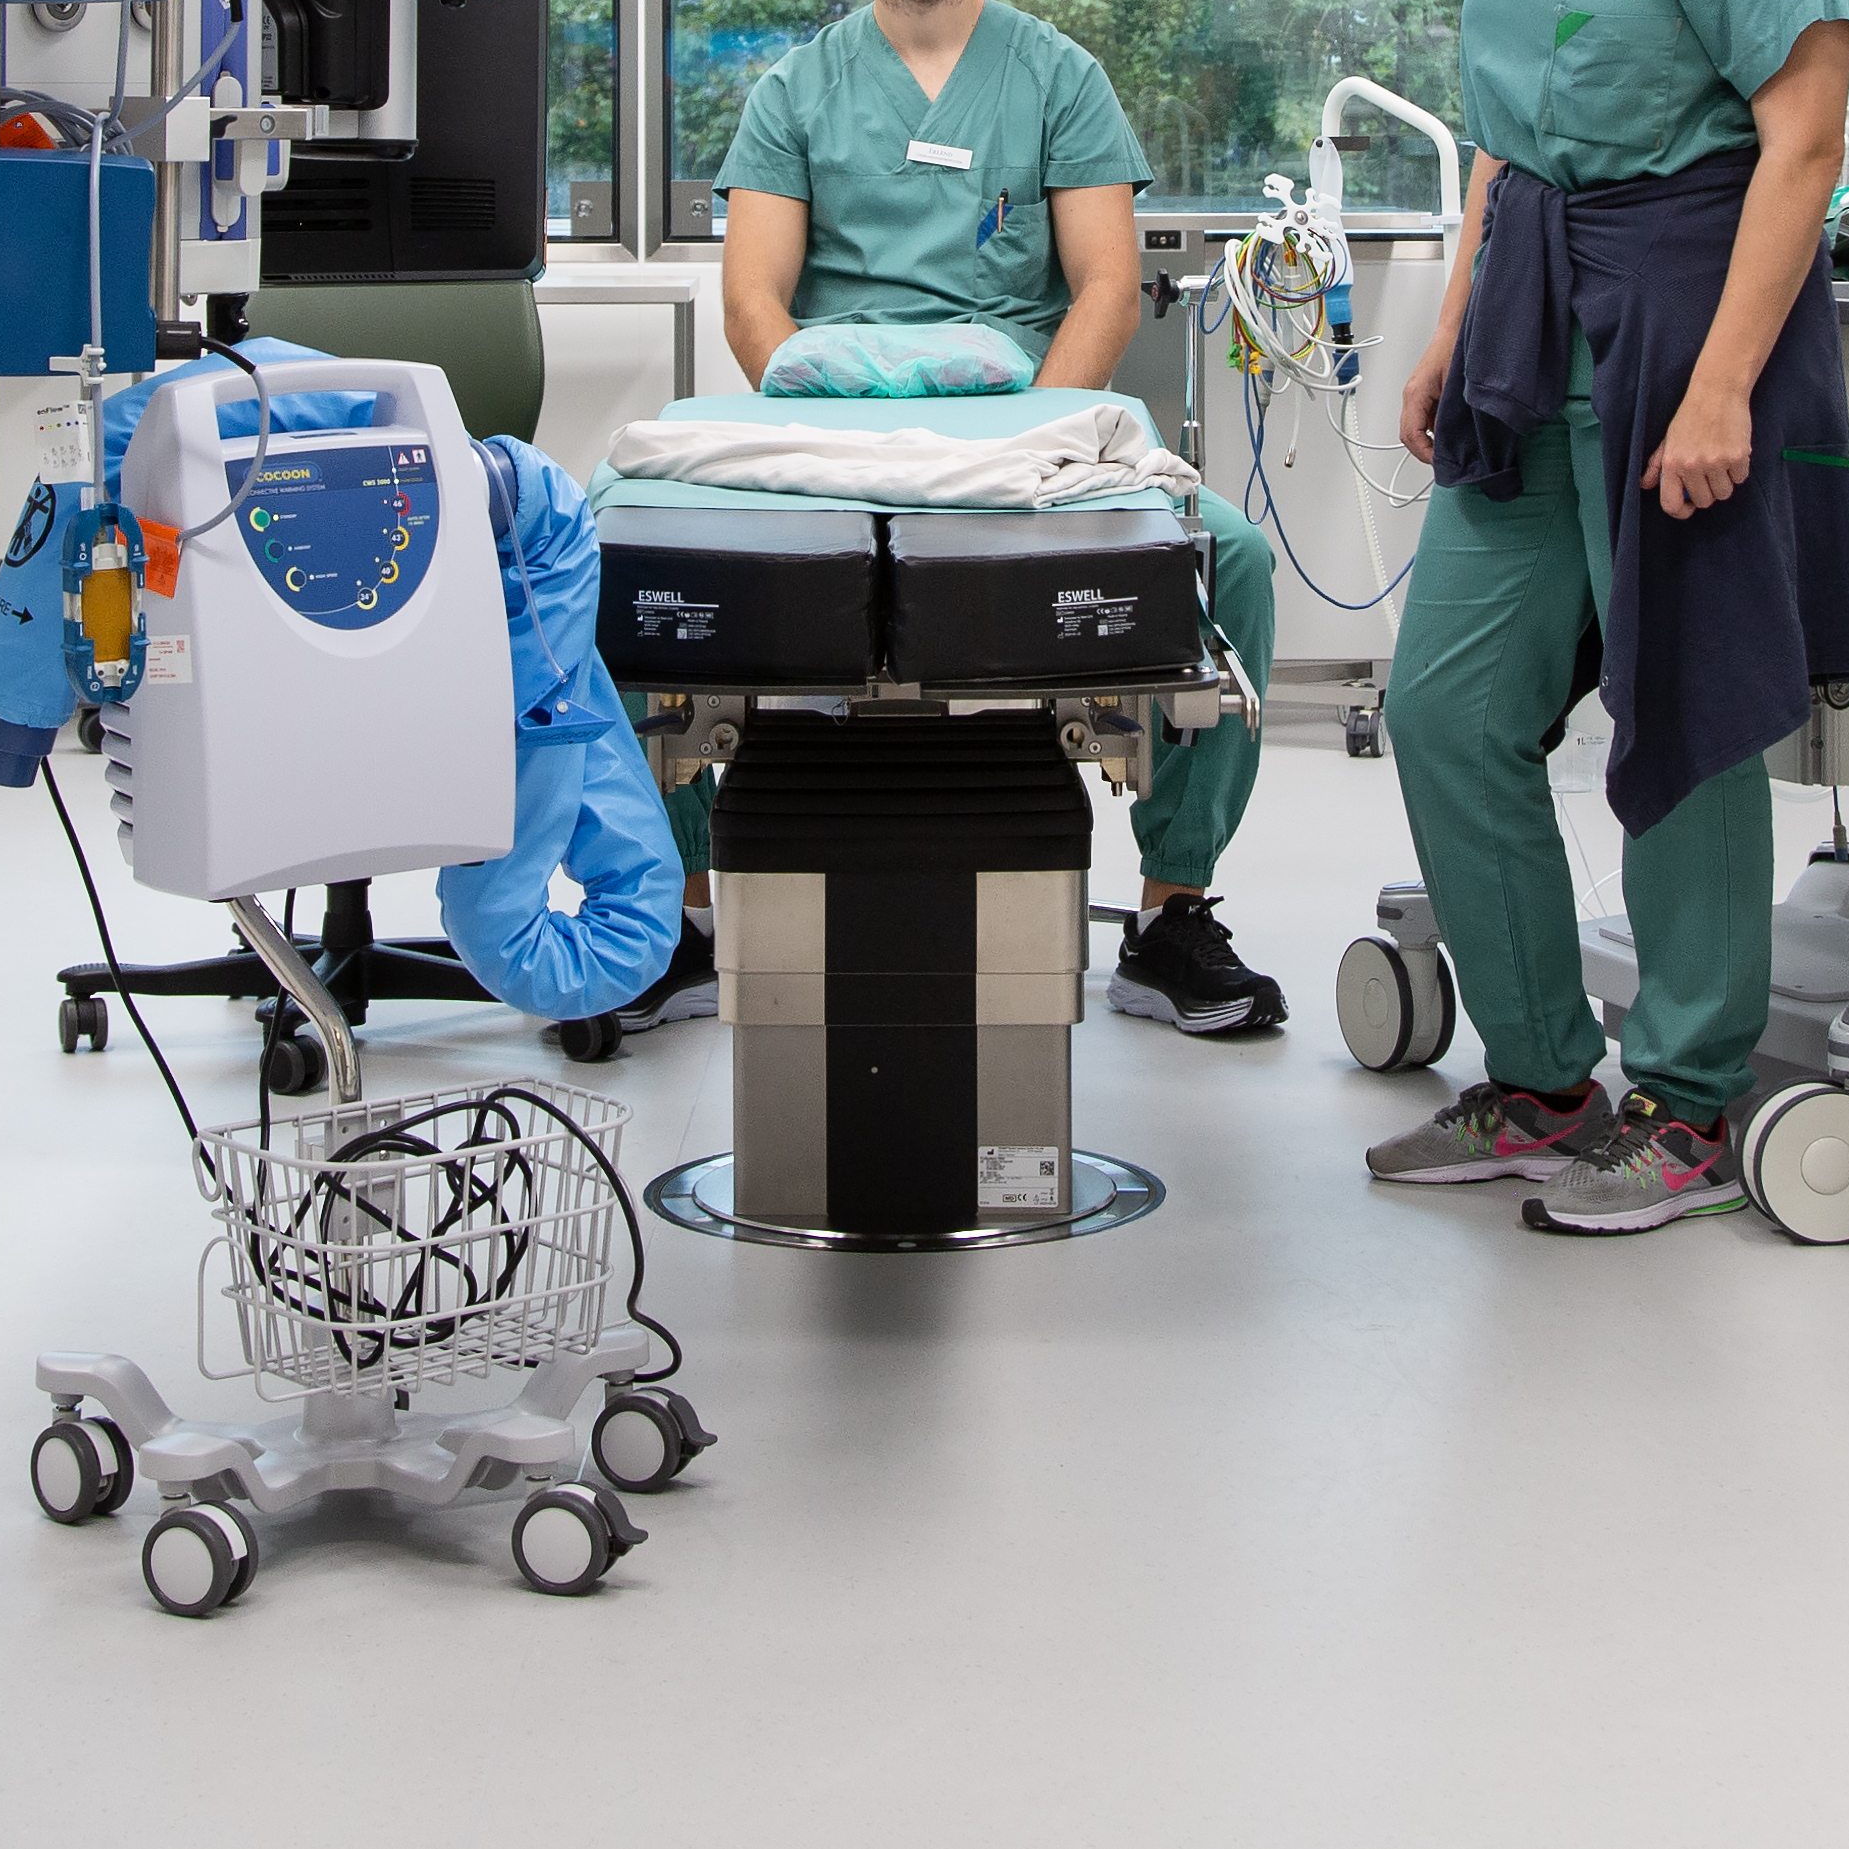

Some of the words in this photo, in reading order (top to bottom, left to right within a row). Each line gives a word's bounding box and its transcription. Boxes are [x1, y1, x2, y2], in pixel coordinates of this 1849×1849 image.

[256, 468, 311, 482] COCOON
[280, 485, 305, 494] WARMING
[306, 483, 326, 492] SYSTEM
[638, 589, 685, 603] ESWELL
[1057, 588, 1105, 603] ESWELL
